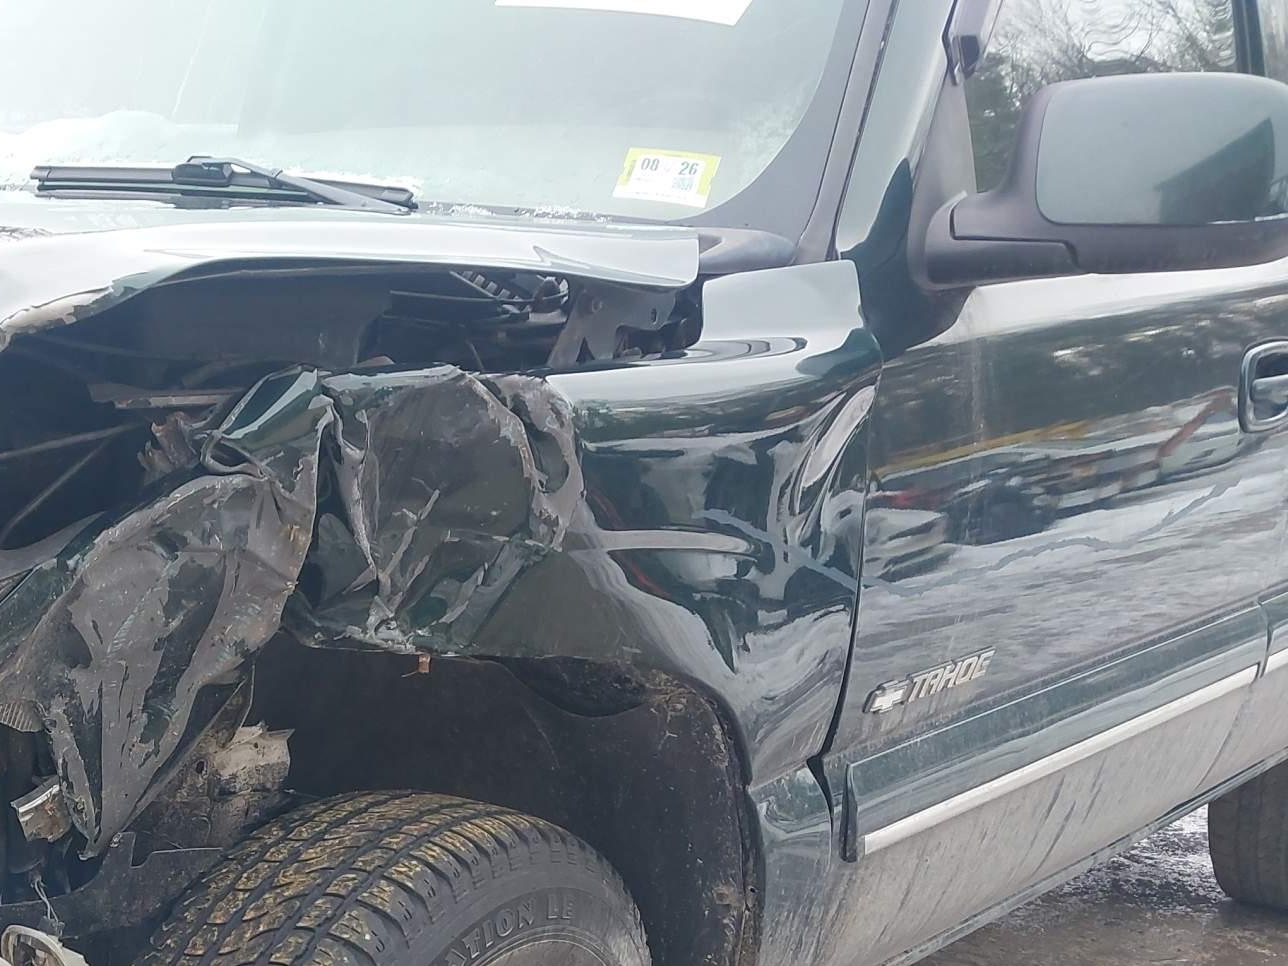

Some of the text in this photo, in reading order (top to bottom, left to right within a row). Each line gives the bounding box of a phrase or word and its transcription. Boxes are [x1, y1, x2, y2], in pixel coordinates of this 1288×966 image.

[678, 161, 700, 176] 26
[907, 649, 997, 703] TAHOE
[546, 896, 574, 920] LE
